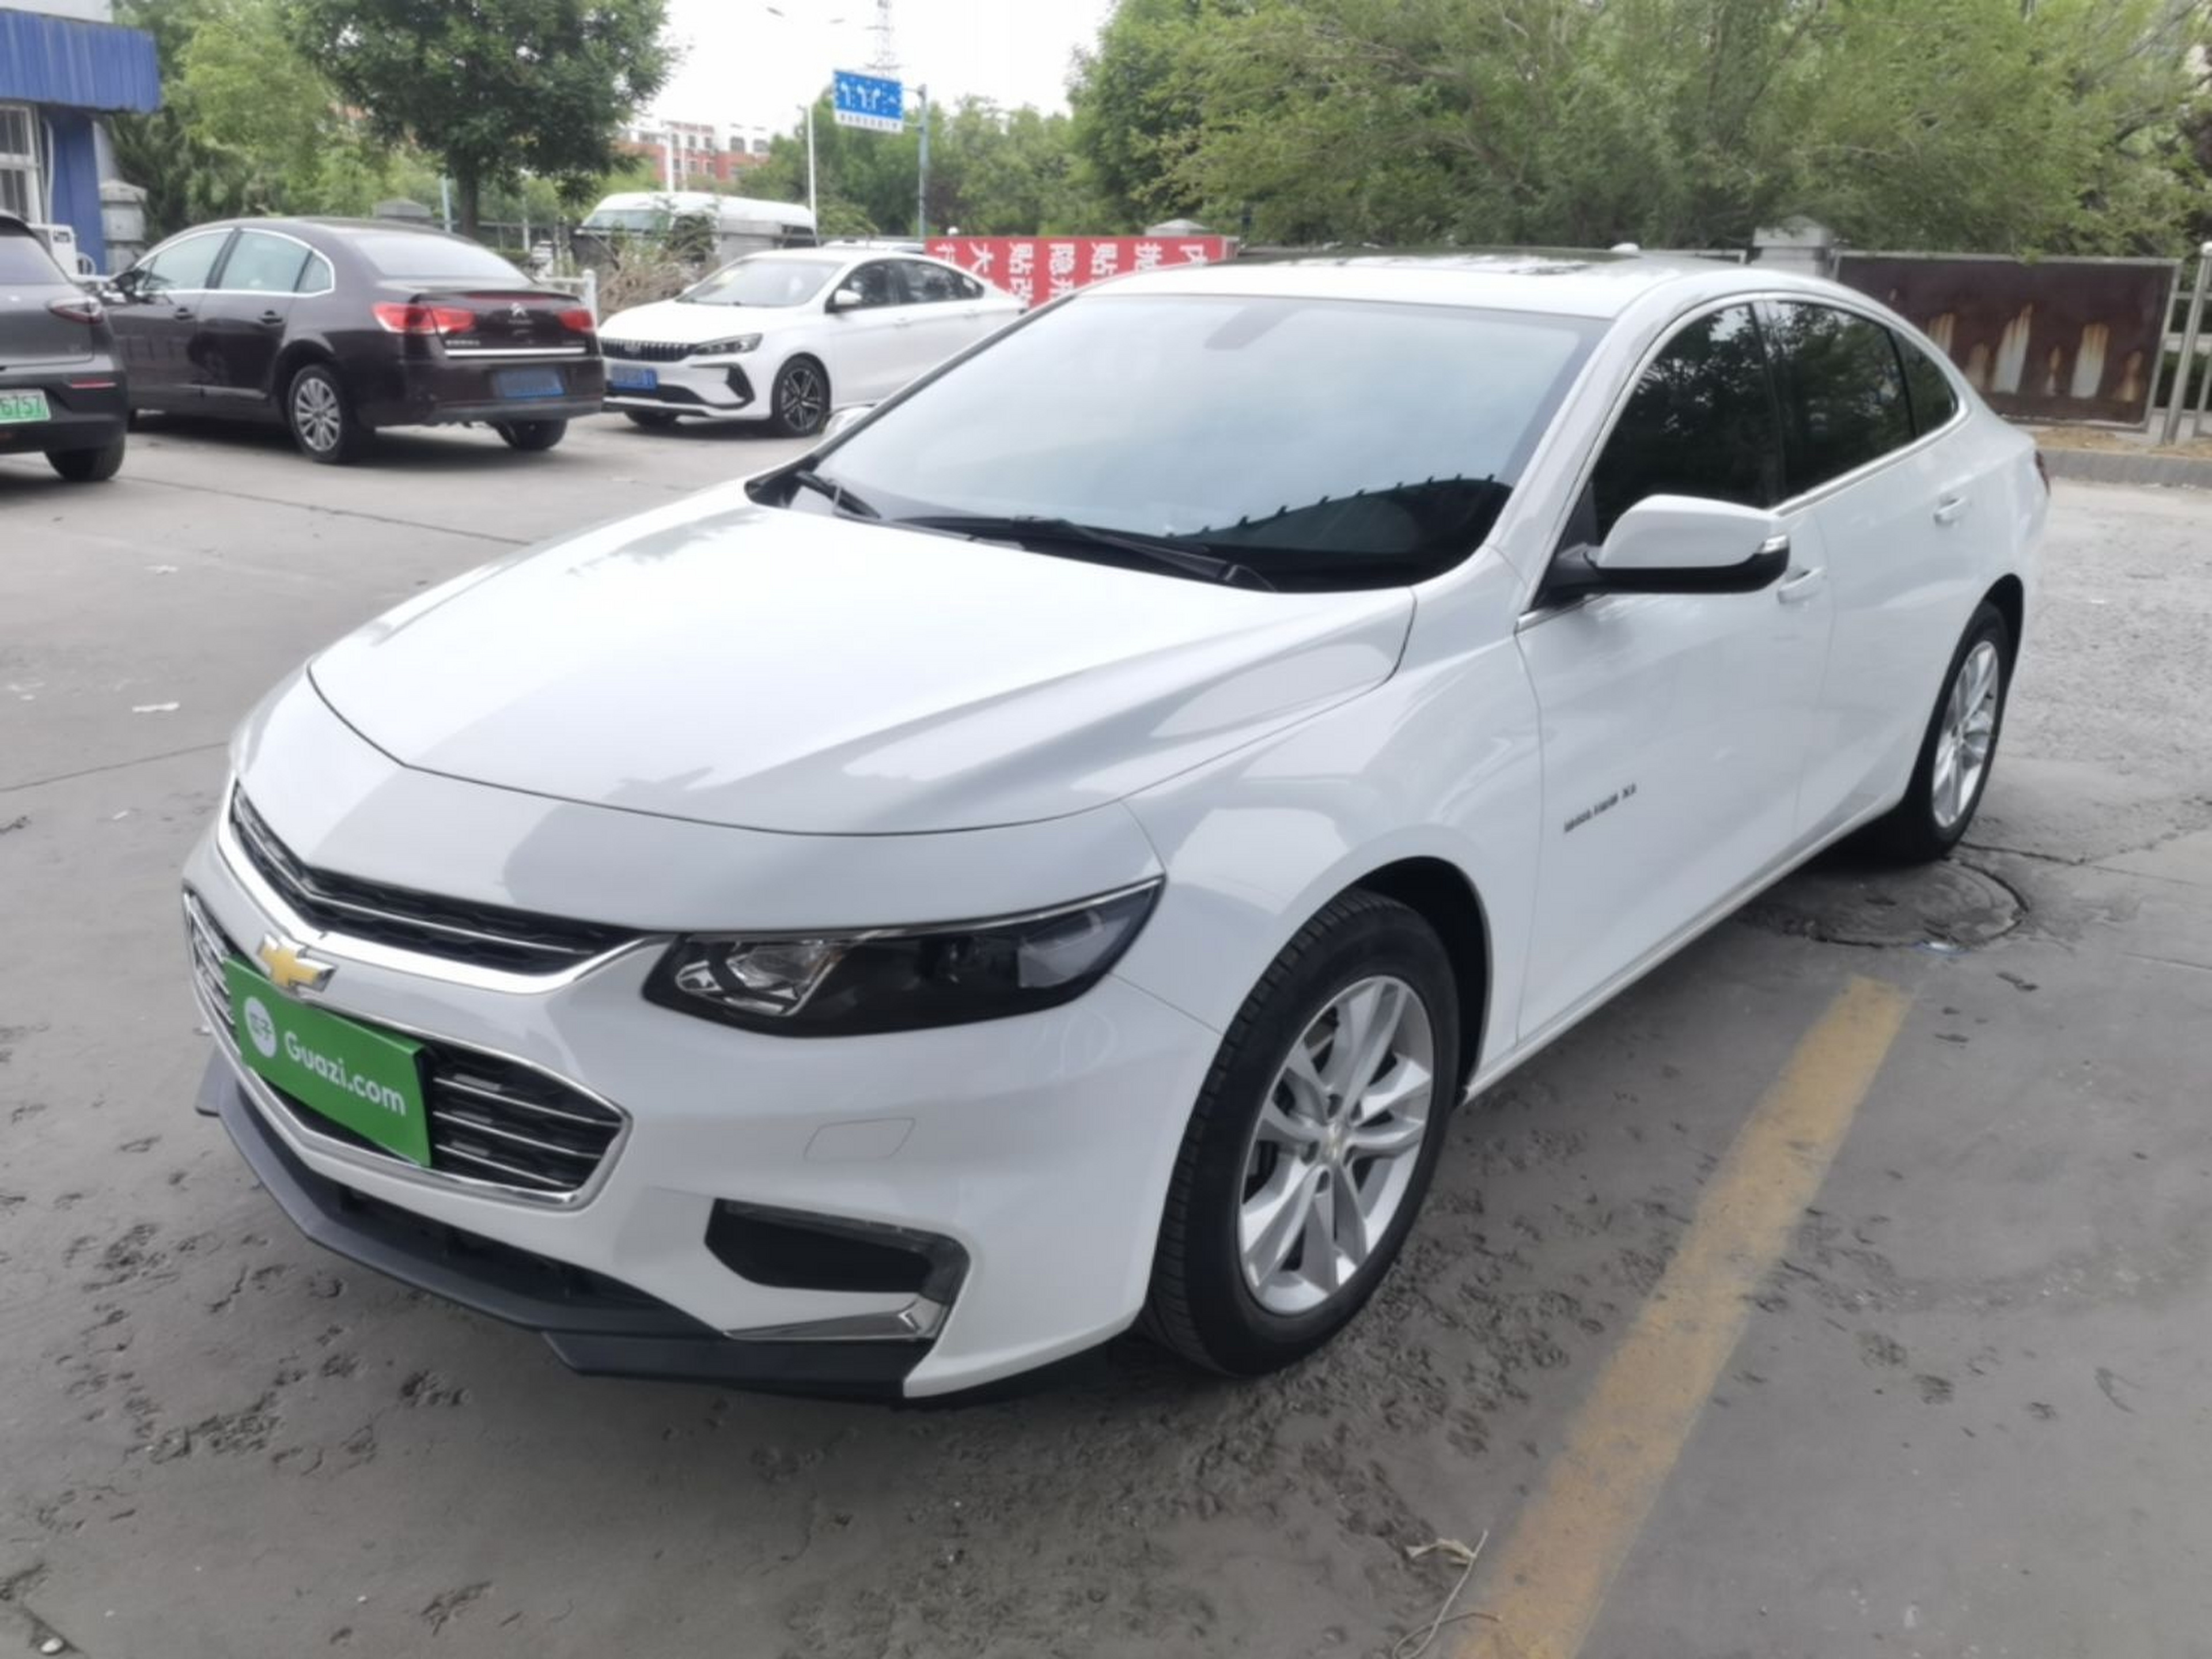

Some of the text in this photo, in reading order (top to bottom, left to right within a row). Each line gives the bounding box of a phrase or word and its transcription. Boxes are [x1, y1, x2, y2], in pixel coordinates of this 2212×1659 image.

[969, 241, 994, 283] 大
[1091, 242, 1118, 282] 贴
[285, 1031, 406, 1116] Guazi.com
